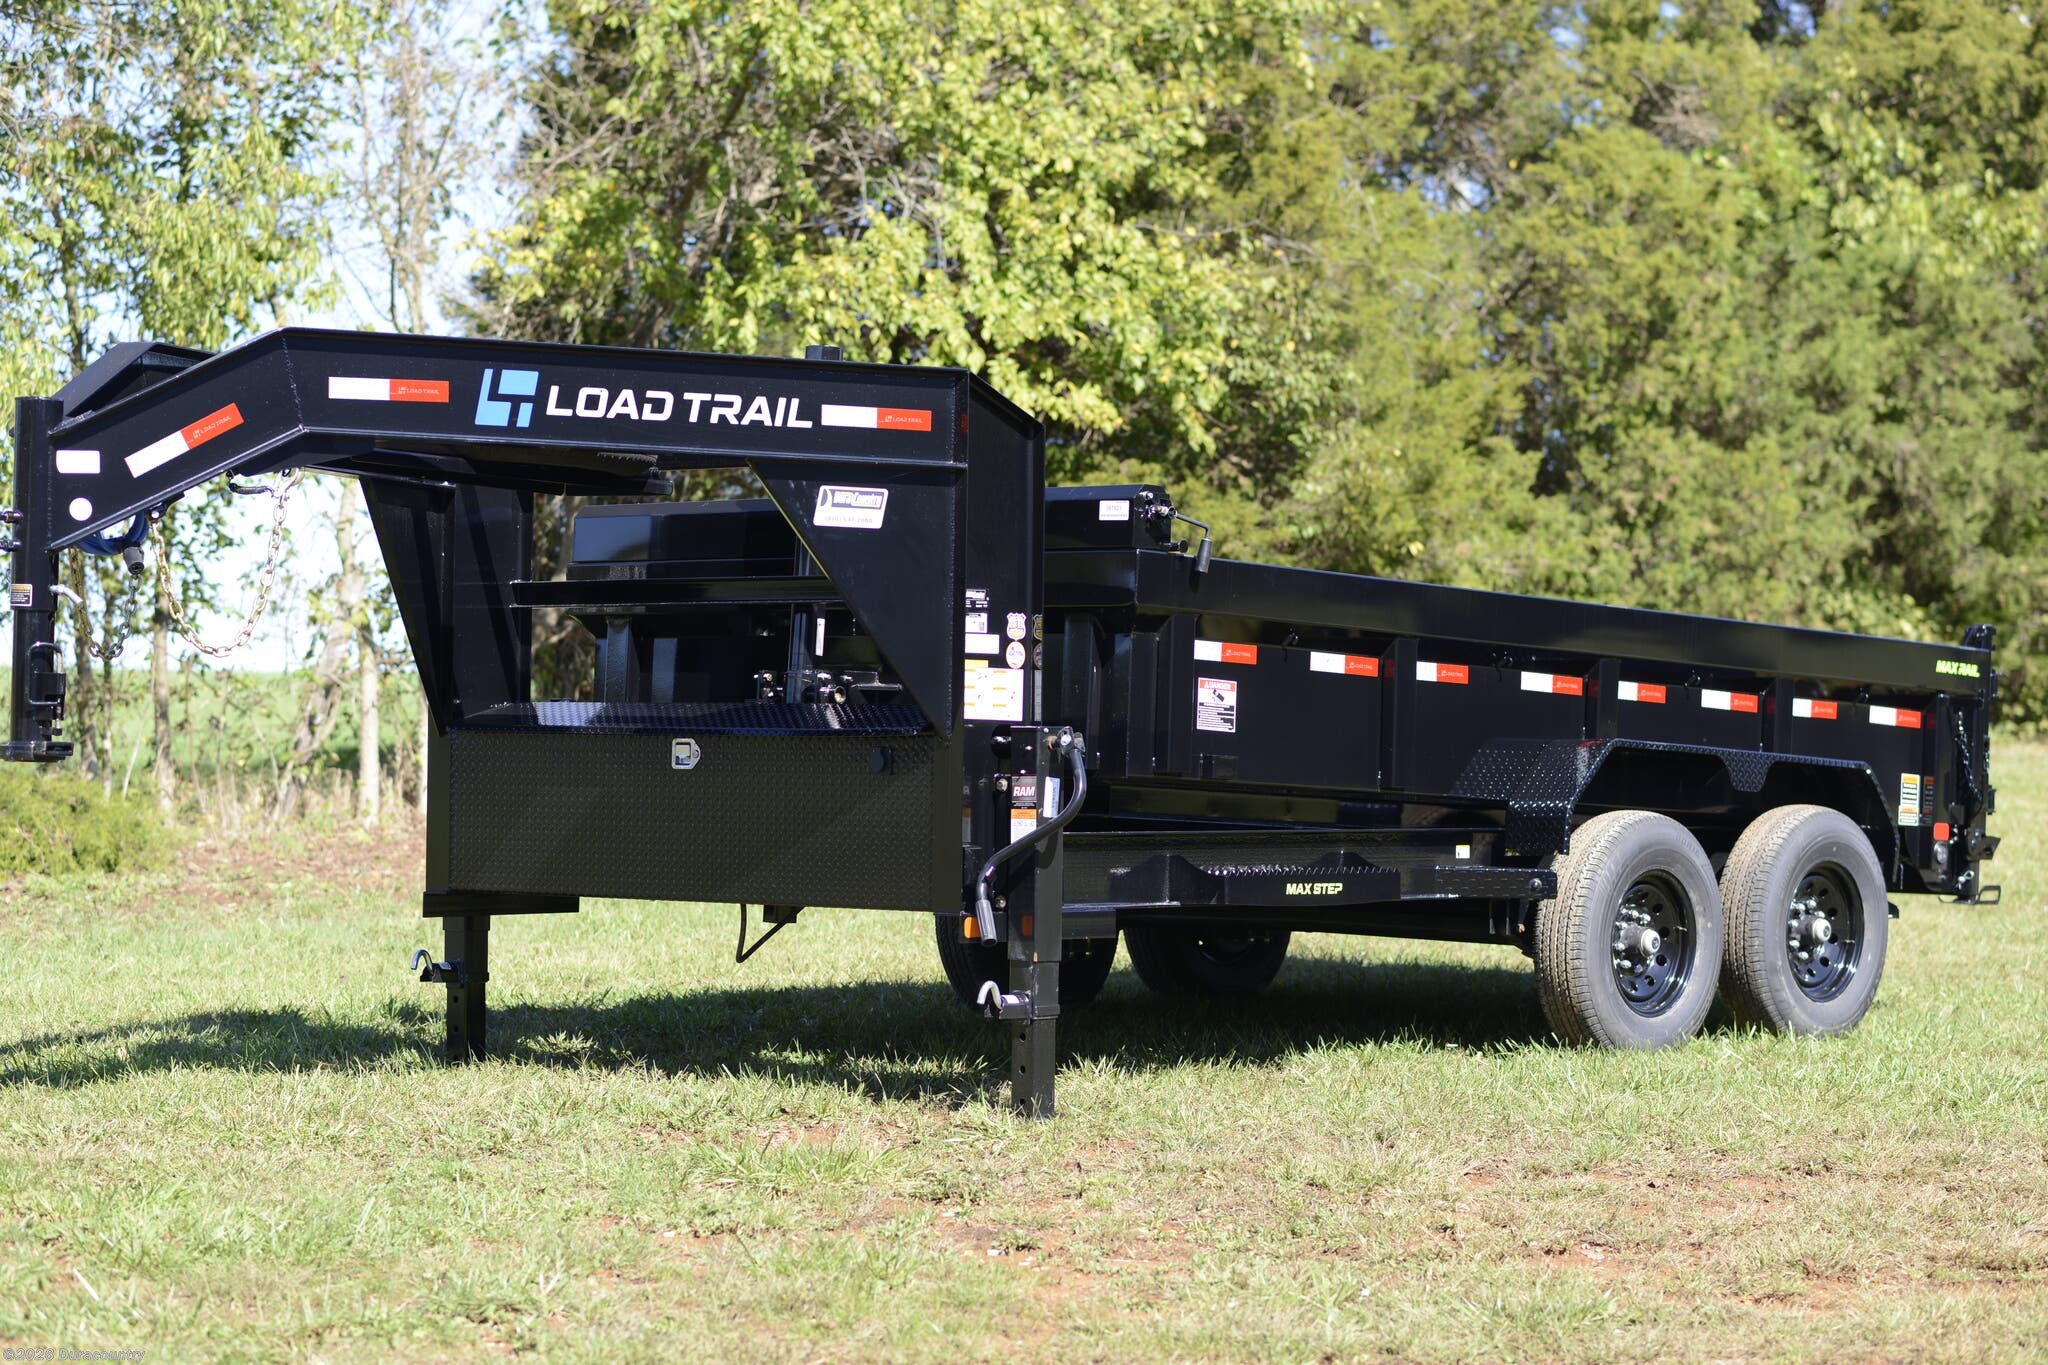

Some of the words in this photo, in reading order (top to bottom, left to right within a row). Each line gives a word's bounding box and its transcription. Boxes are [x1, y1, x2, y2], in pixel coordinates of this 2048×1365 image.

[545, 385, 675, 422] LOAD
[683, 392, 814, 429] TRAIL
[1936, 659, 1959, 675] MAX
[1958, 662, 1980, 678] RAIL
[1013, 786, 1035, 797] RAM
[1286, 883, 1312, 895] MAX
[1313, 883, 1343, 895] STEP
